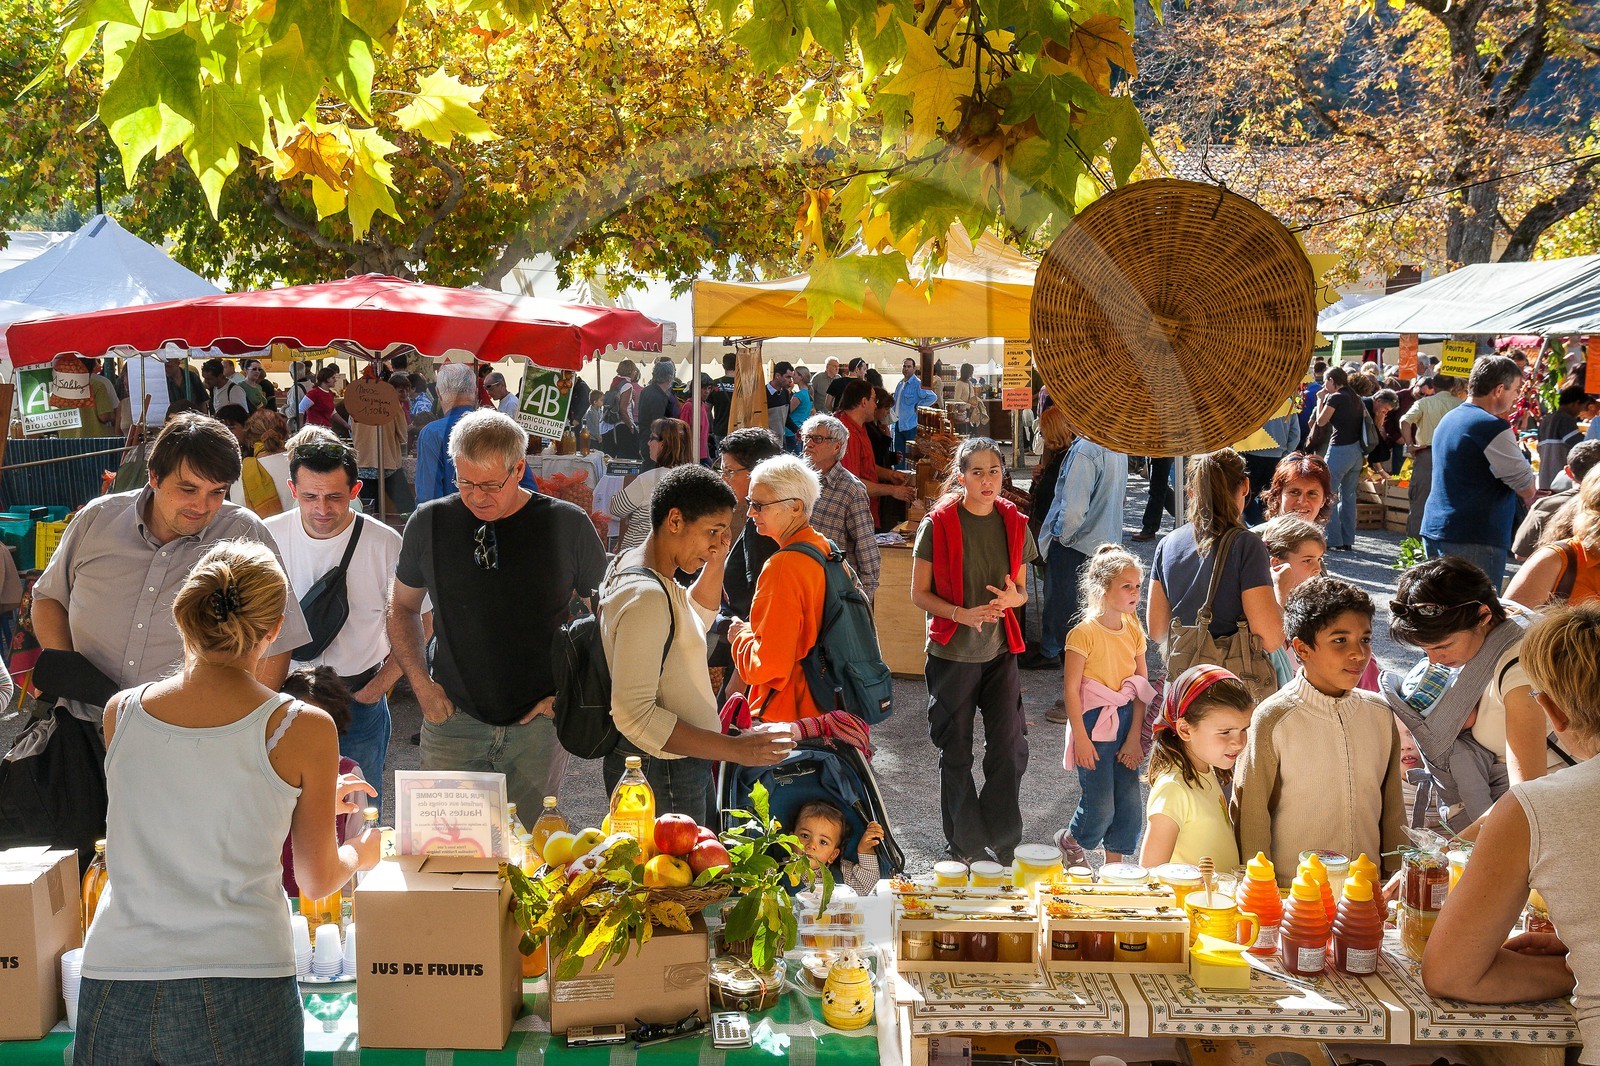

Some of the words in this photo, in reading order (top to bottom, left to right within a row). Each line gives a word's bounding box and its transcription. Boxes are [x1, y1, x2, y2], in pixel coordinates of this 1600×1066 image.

[1446, 345, 1464, 353] FRUITS
[1446, 355, 1469, 363] CANTON
[523, 384, 561, 417] AB
[24, 410, 79, 424] AGRICULTURE
[25, 417, 79, 430] BIOLOGIQUE
[518, 413, 564, 430] AGRICULTURE
[0, 956, 19, 969] TS
[371, 962, 399, 975] JUS
[403, 963, 424, 976] DE
[427, 963, 484, 976] FRUITS
